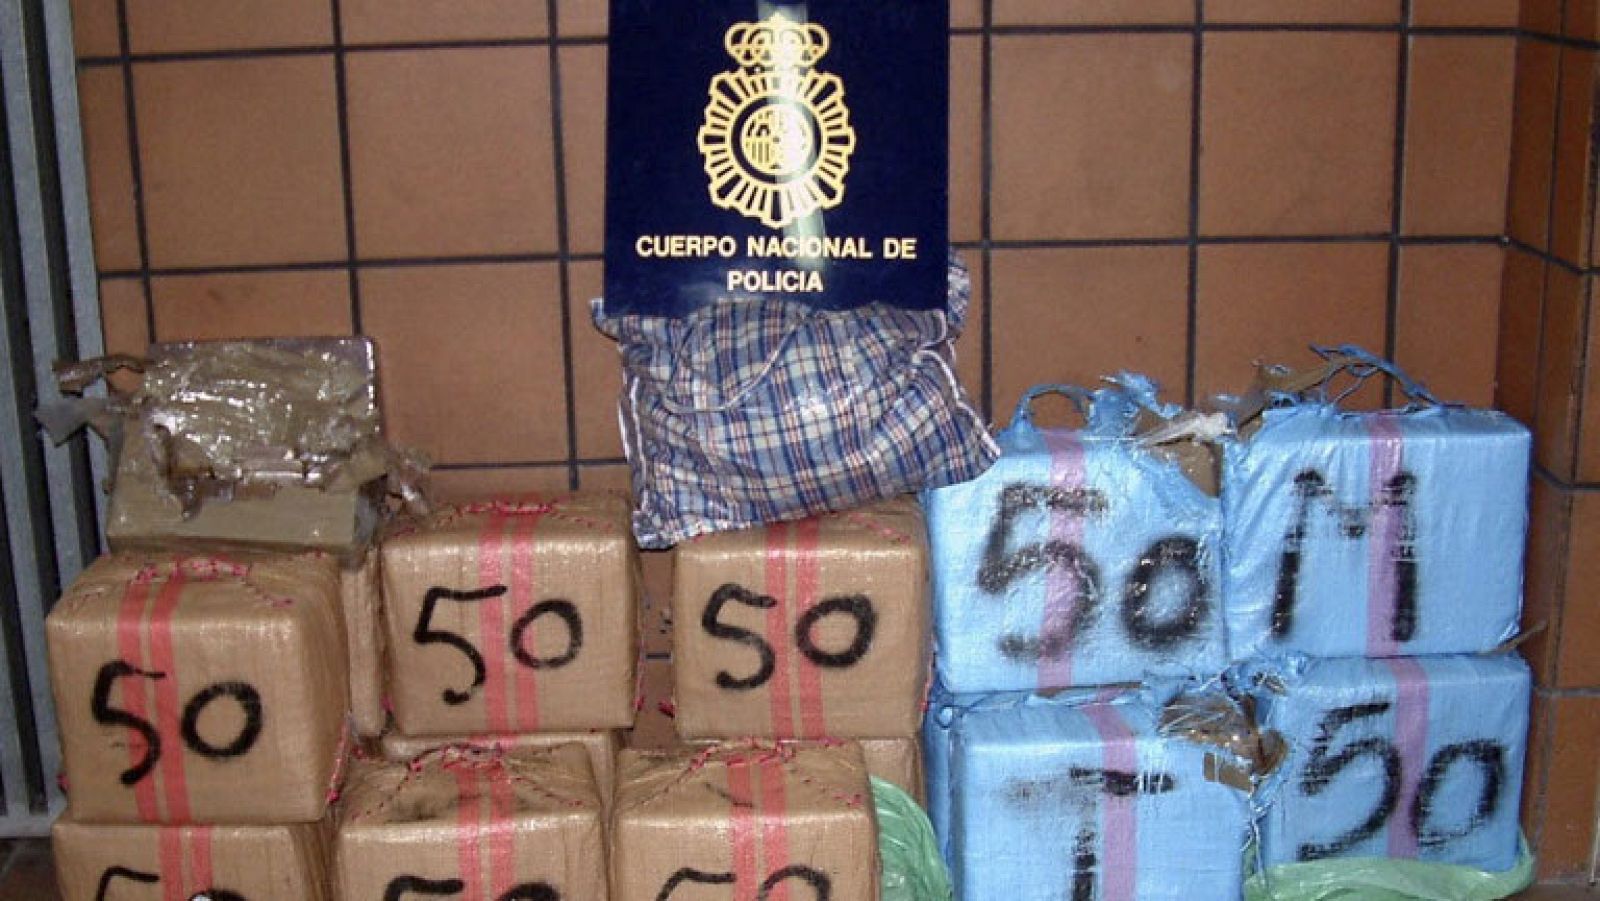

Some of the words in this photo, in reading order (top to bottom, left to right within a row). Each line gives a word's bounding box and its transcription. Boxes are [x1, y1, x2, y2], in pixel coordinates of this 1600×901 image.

[635, 235, 737, 259] CUERPO
[747, 236, 873, 259] NACIONAL
[883, 238, 918, 260] DE
[727, 270, 824, 293] POLICIA
[977, 480, 1213, 662] 50
[1269, 468, 1419, 643] M
[413, 584, 584, 706] 50
[701, 583, 878, 690] 50
[90, 660, 263, 786] 50
[1299, 695, 1508, 862] 50
